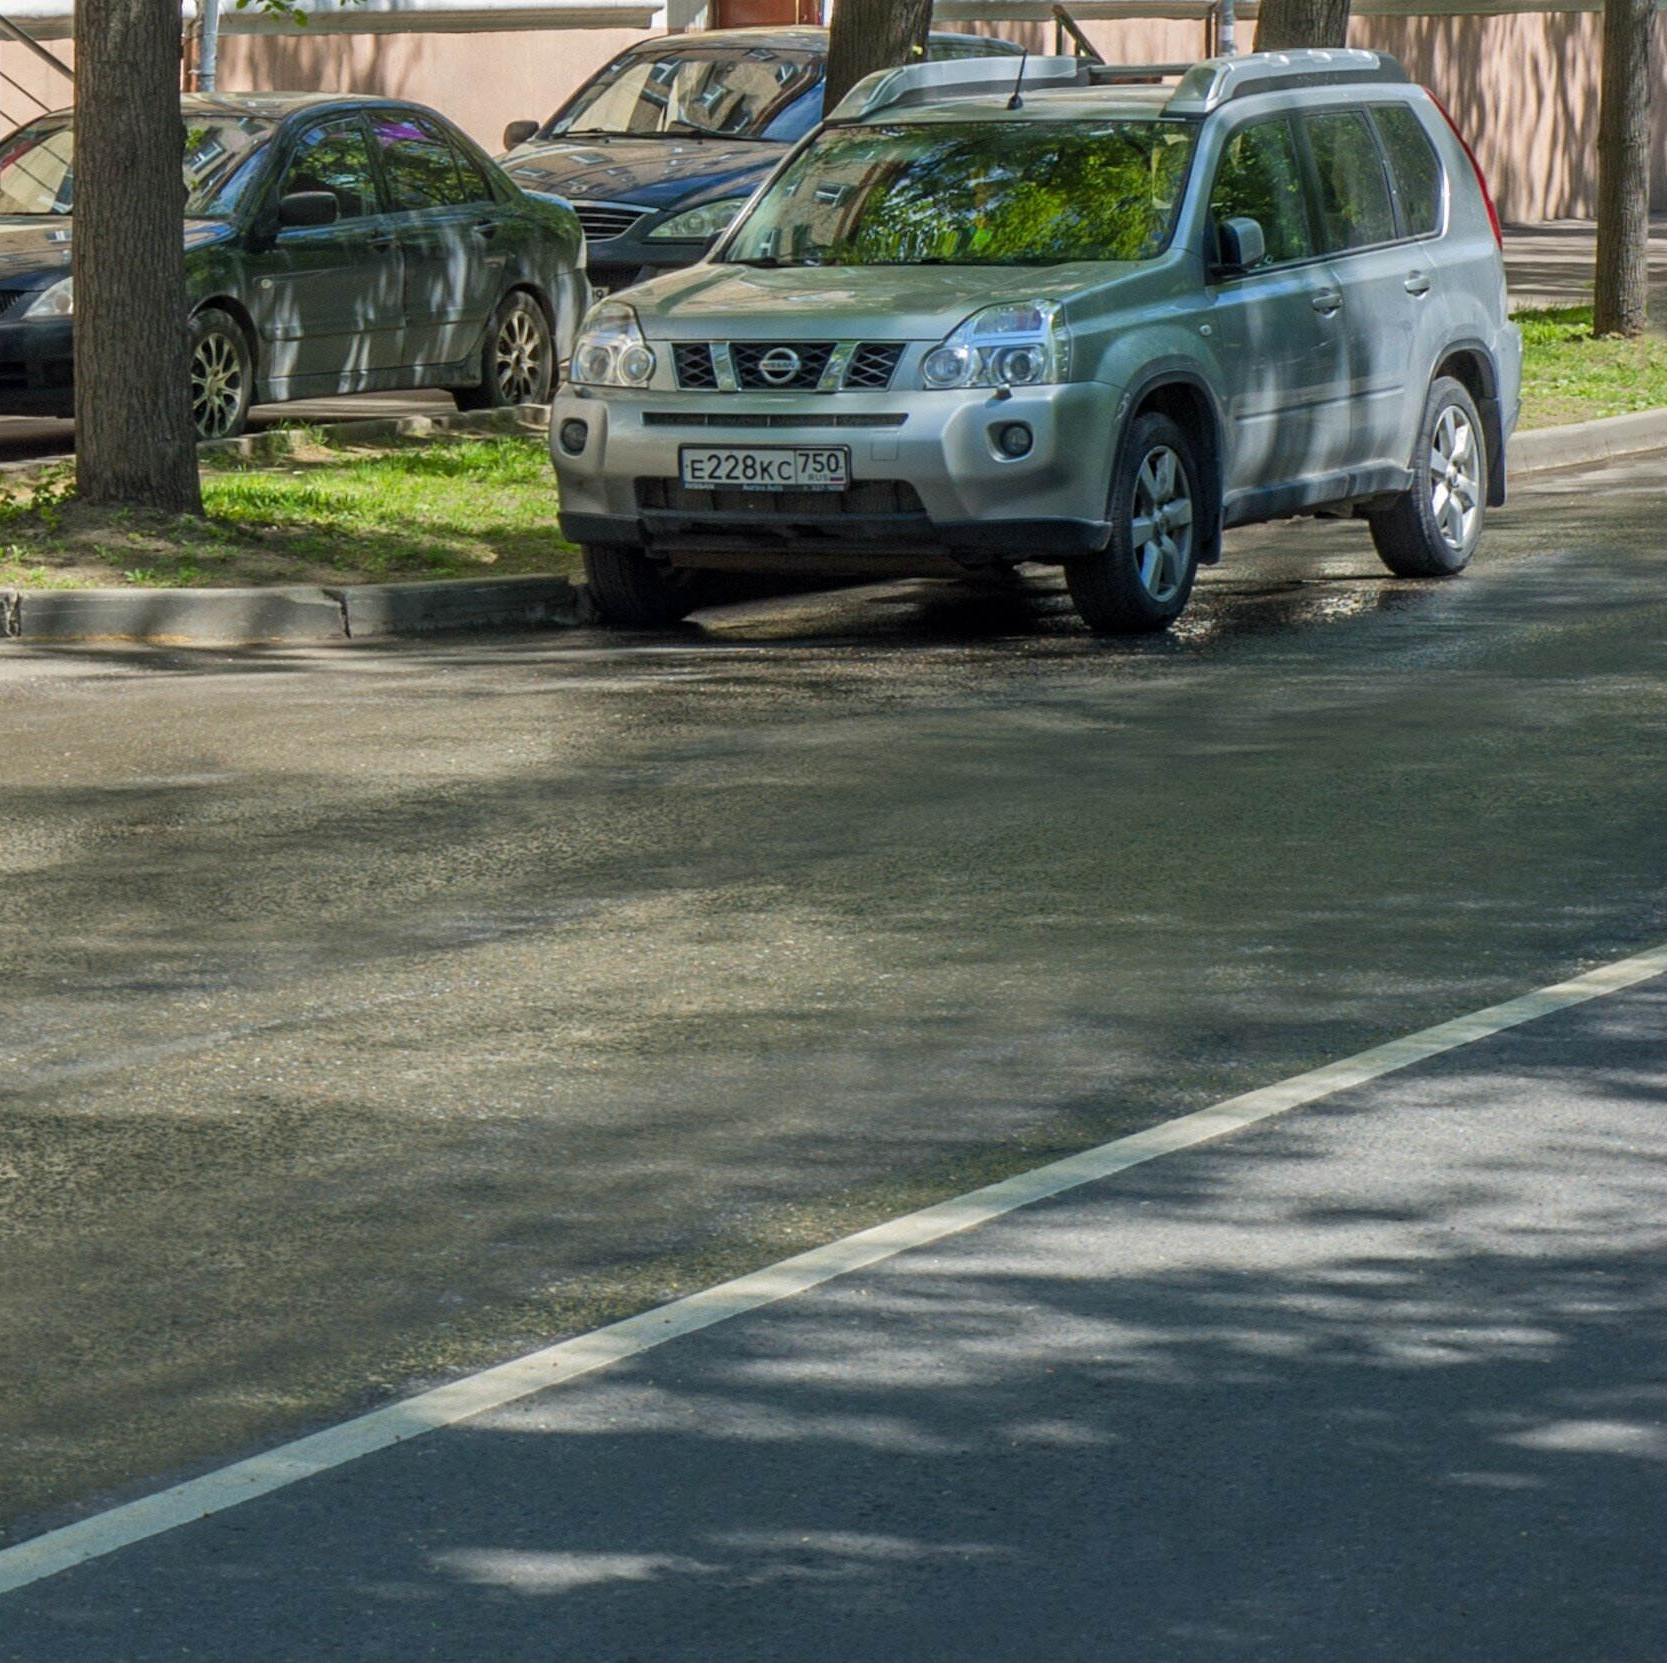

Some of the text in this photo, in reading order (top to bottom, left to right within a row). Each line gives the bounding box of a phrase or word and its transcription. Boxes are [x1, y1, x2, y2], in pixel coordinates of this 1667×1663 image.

[690, 452, 840, 481] Е228КС 750
[808, 474, 829, 482] RUS
